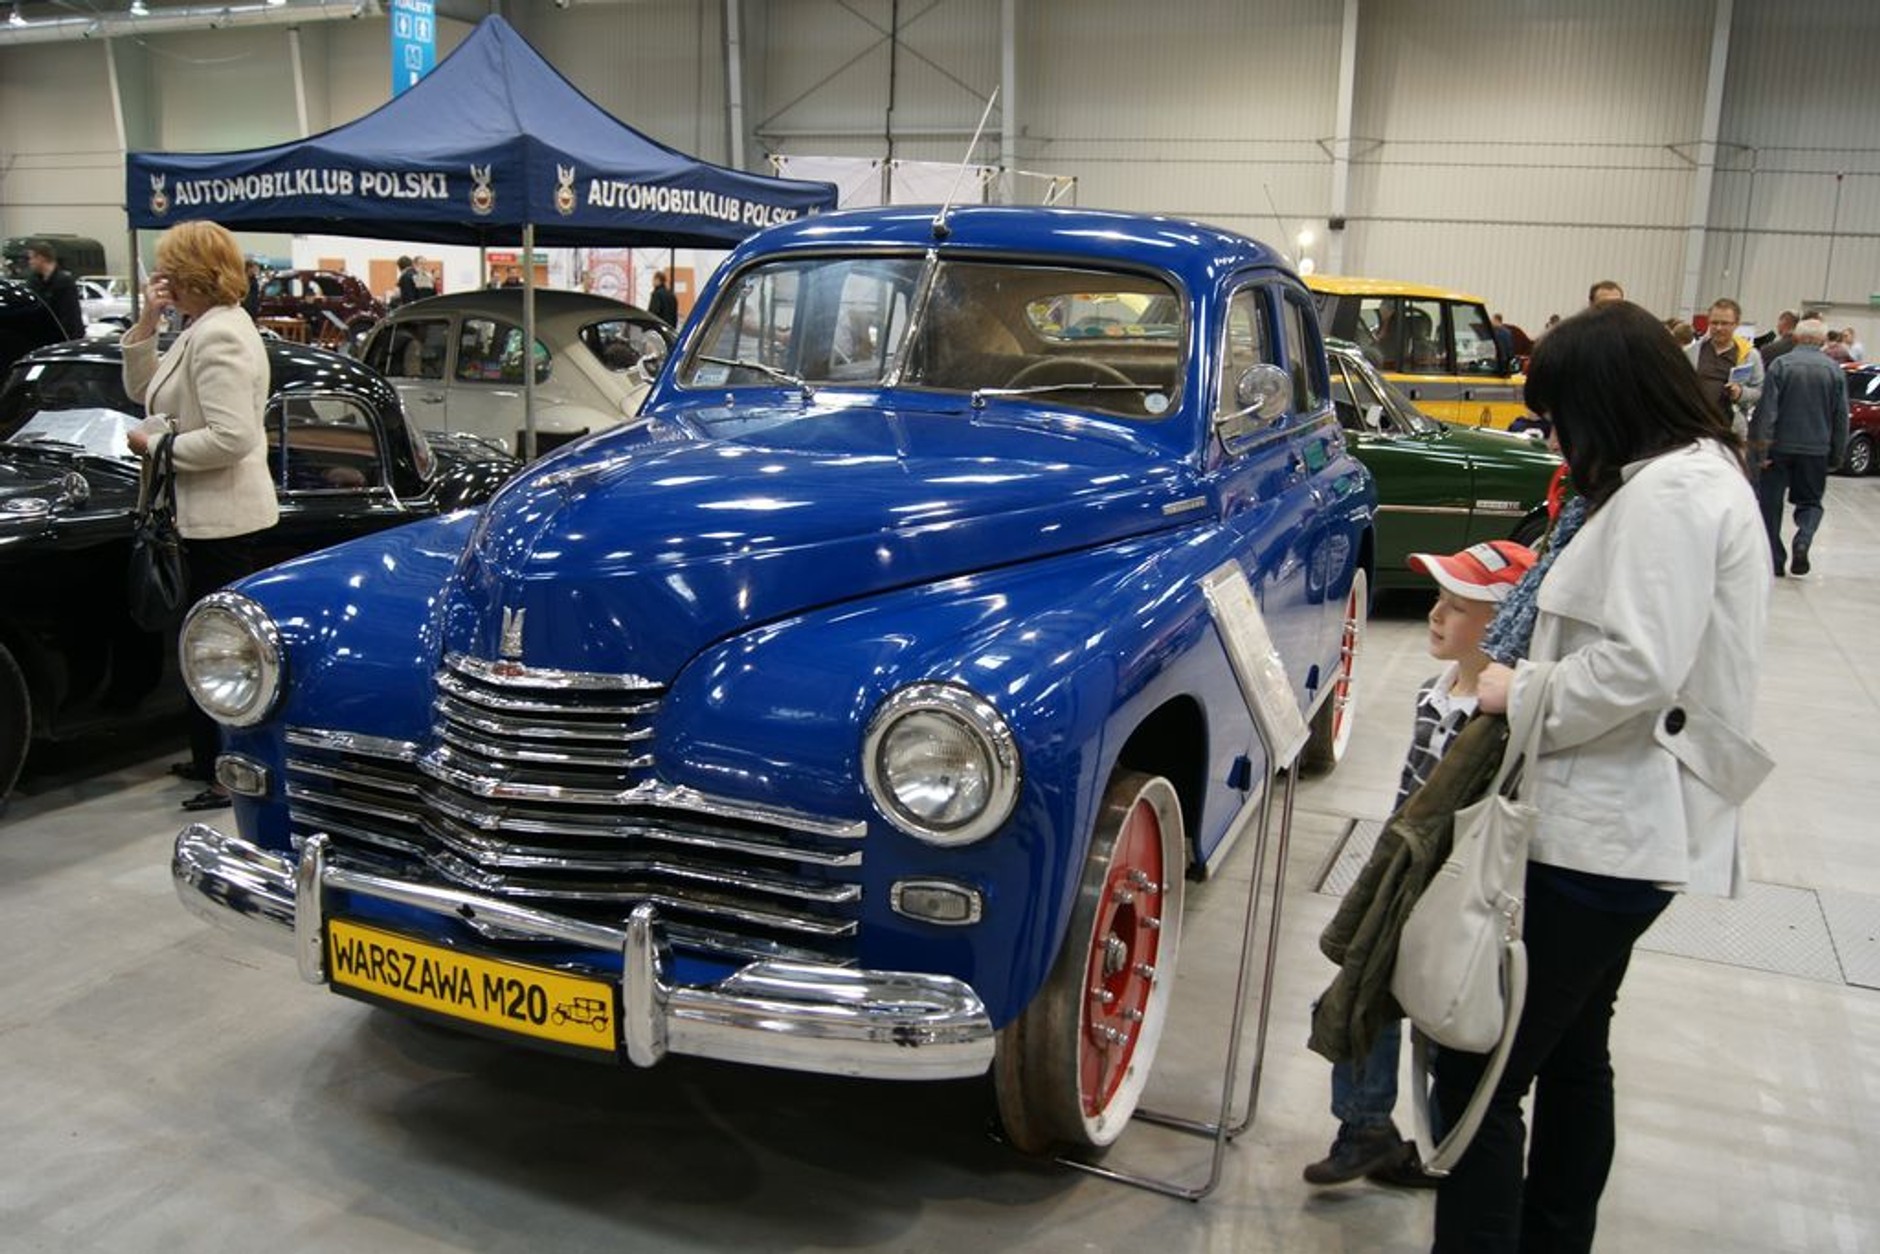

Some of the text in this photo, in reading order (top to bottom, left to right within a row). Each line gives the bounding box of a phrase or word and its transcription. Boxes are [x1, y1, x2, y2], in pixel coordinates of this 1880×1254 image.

[175, 168, 449, 205] AUTOMOBILKLUB POLSKI
[588, 178, 740, 222] AUTOMOBILKLUB
[333, 933, 548, 1026] WARSZAWA M20
